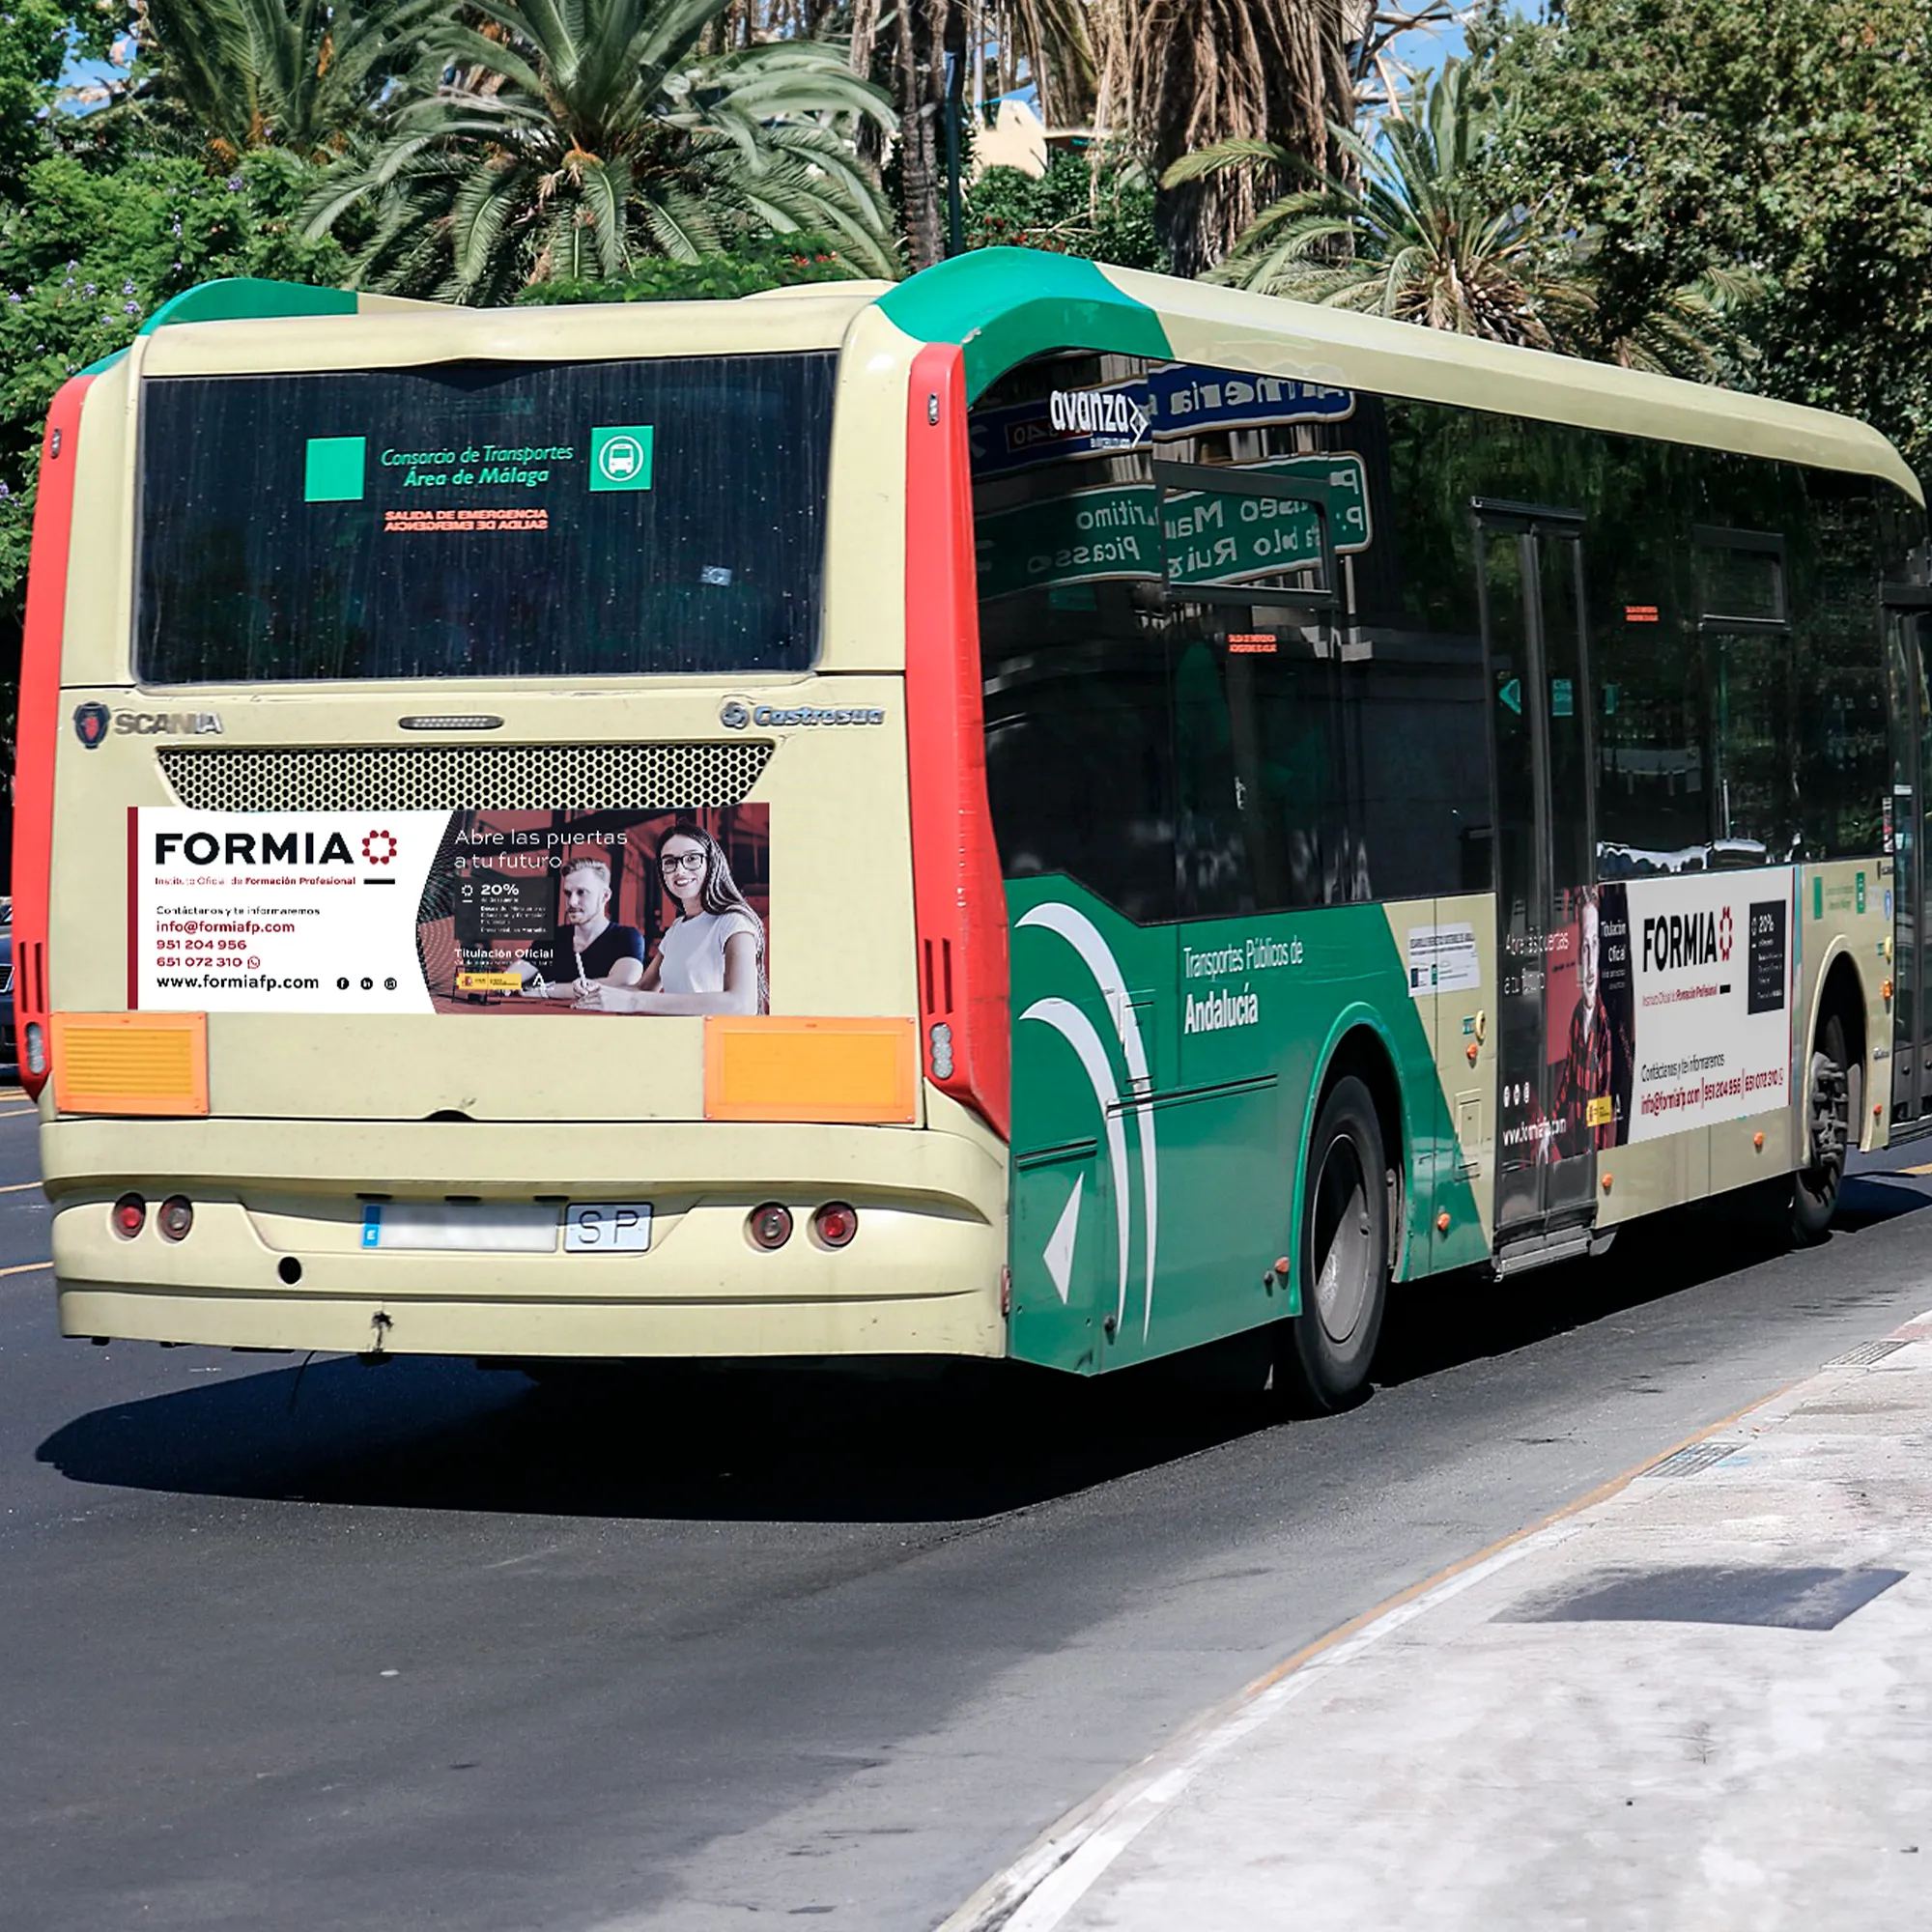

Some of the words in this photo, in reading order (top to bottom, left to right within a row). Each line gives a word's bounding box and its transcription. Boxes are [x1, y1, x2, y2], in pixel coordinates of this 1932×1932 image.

[1050, 390, 1129, 433] avanza
[381, 448, 456, 466] Consorcio
[460, 446, 480, 463] de
[484, 444, 574, 466] Transportes
[403, 467, 446, 487] Área
[452, 468, 473, 485] de
[478, 467, 550, 487] Málaga
[384, 510, 434, 521] SALIDA
[436, 510, 456, 520] DE
[457, 509, 549, 520] EMERGENCIA
[114, 713, 224, 735] SCANIA
[454, 829, 504, 846] Abre
[511, 829, 540, 846] las
[547, 830, 629, 849] puertas
[156, 832, 355, 866] FORMIA
[454, 857, 468, 869] a
[472, 855, 494, 869] tu
[498, 851, 563, 869] futuro
[155, 876, 194, 886] Instituto
[197, 876, 228, 886] Oficial
[231, 876, 243, 886] de
[245, 876, 297, 886] Formación
[299, 876, 356, 886] Profesional
[481, 883, 520, 895] 20%
[156, 905, 224, 916] Contáctanos
[225, 908, 232, 918] y
[234, 906, 244, 915] te
[247, 906, 321, 916] informaremos
[156, 921, 296, 935] info@formiafp.com
[1758, 914, 1776, 934] 20%
[156, 939, 181, 951] 951
[185, 939, 214, 951] 204
[217, 939, 247, 951] 956
[1643, 911, 1719, 973] FORMIA
[454, 948, 512, 958] Titulación
[515, 949, 554, 958] Oficial
[1183, 943, 1244, 982] Transportes
[1246, 937, 1289, 970] Públicos
[1290, 935, 1303, 964] de
[156, 957, 181, 968] 651
[185, 957, 213, 968] 072
[216, 957, 242, 968] 310
[156, 975, 320, 992] www.formiafp.com
[1184, 981, 1259, 1035] Andalucía
[366, 1230, 377, 1240] E
